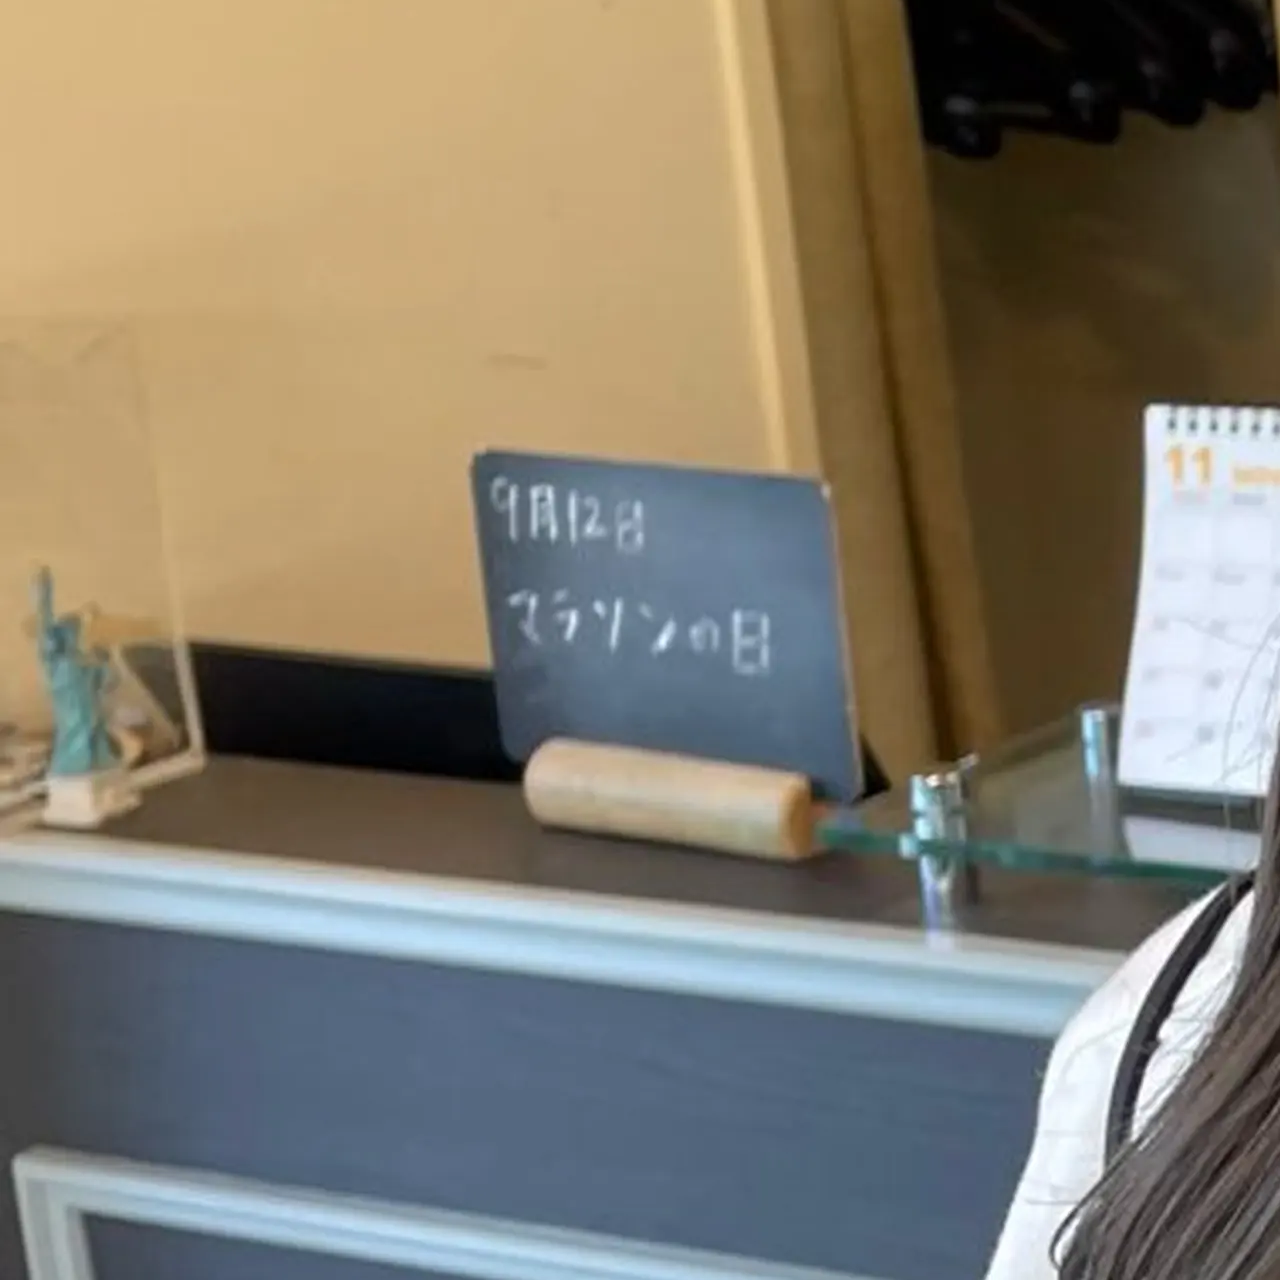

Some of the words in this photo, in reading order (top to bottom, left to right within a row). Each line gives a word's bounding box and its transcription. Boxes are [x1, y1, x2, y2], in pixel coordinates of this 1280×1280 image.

[1165, 444, 1214, 488] 11
[491, 476, 645, 553] 9月12日
[508, 589, 771, 675] マラソンの日
